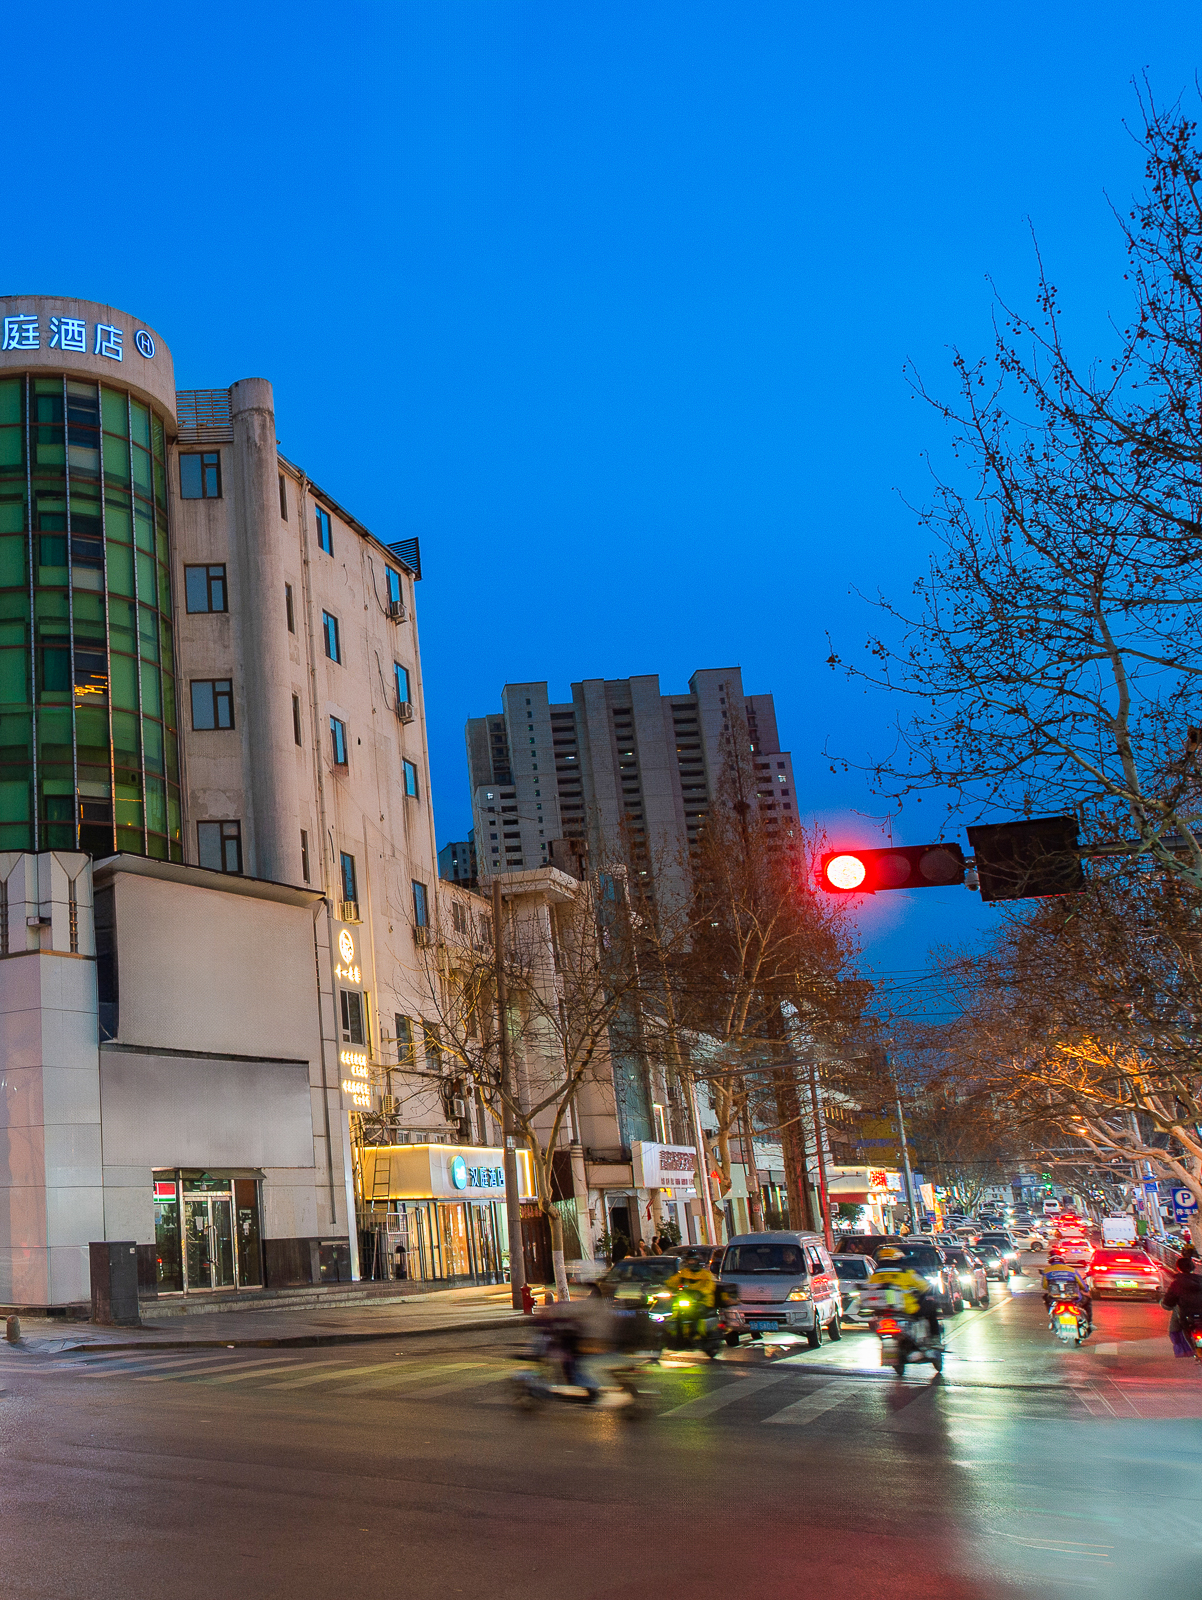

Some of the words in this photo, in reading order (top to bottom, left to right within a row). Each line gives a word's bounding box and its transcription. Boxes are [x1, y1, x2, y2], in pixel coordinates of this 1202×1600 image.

[469, 1166, 505, 1188] 汉庭酒店
[1181, 1192, 1191, 1204] P
